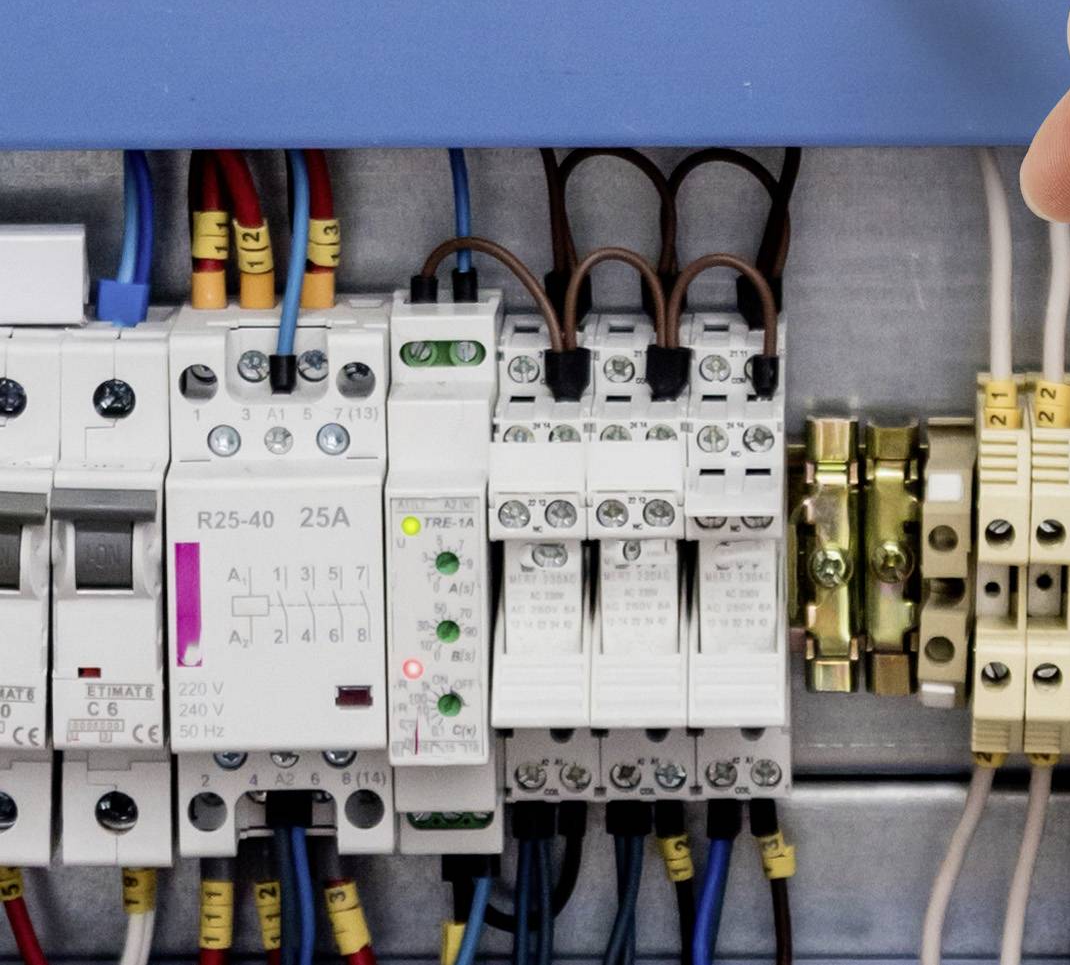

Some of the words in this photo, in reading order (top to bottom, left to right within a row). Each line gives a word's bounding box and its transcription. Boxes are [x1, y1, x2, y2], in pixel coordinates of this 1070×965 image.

[242, 408, 250, 421] 3
[267, 408, 285, 421] A1
[303, 408, 312, 421] 5
[334, 408, 343, 421] 7
[349, 407, 379, 423] (13)
[198, 510, 274, 529] R25-40
[300, 507, 350, 528] 25A
[424, 517, 474, 529] TRE-1A
[273, 567, 280, 581] 1
[300, 567, 310, 581] 3
[328, 567, 338, 581] 5
[356, 567, 365, 580] 7
[274, 629, 284, 644] 2
[300, 629, 311, 643] 4
[329, 629, 340, 643] 6
[357, 629, 367, 642] 8
[178, 682, 207, 696] 220
[212, 682, 224, 695] V
[87, 701, 99, 716] C
[107, 702, 118, 717] 6
[178, 704, 208, 717] 240
[212, 703, 224, 717] V
[180, 725, 198, 739] 50
[203, 724, 225, 738] Hz
[201, 775, 210, 787] 2
[249, 774, 259, 786] 4
[275, 773, 295, 785] A2
[311, 772, 320, 785] 6
[356, 771, 387, 787] (14)
